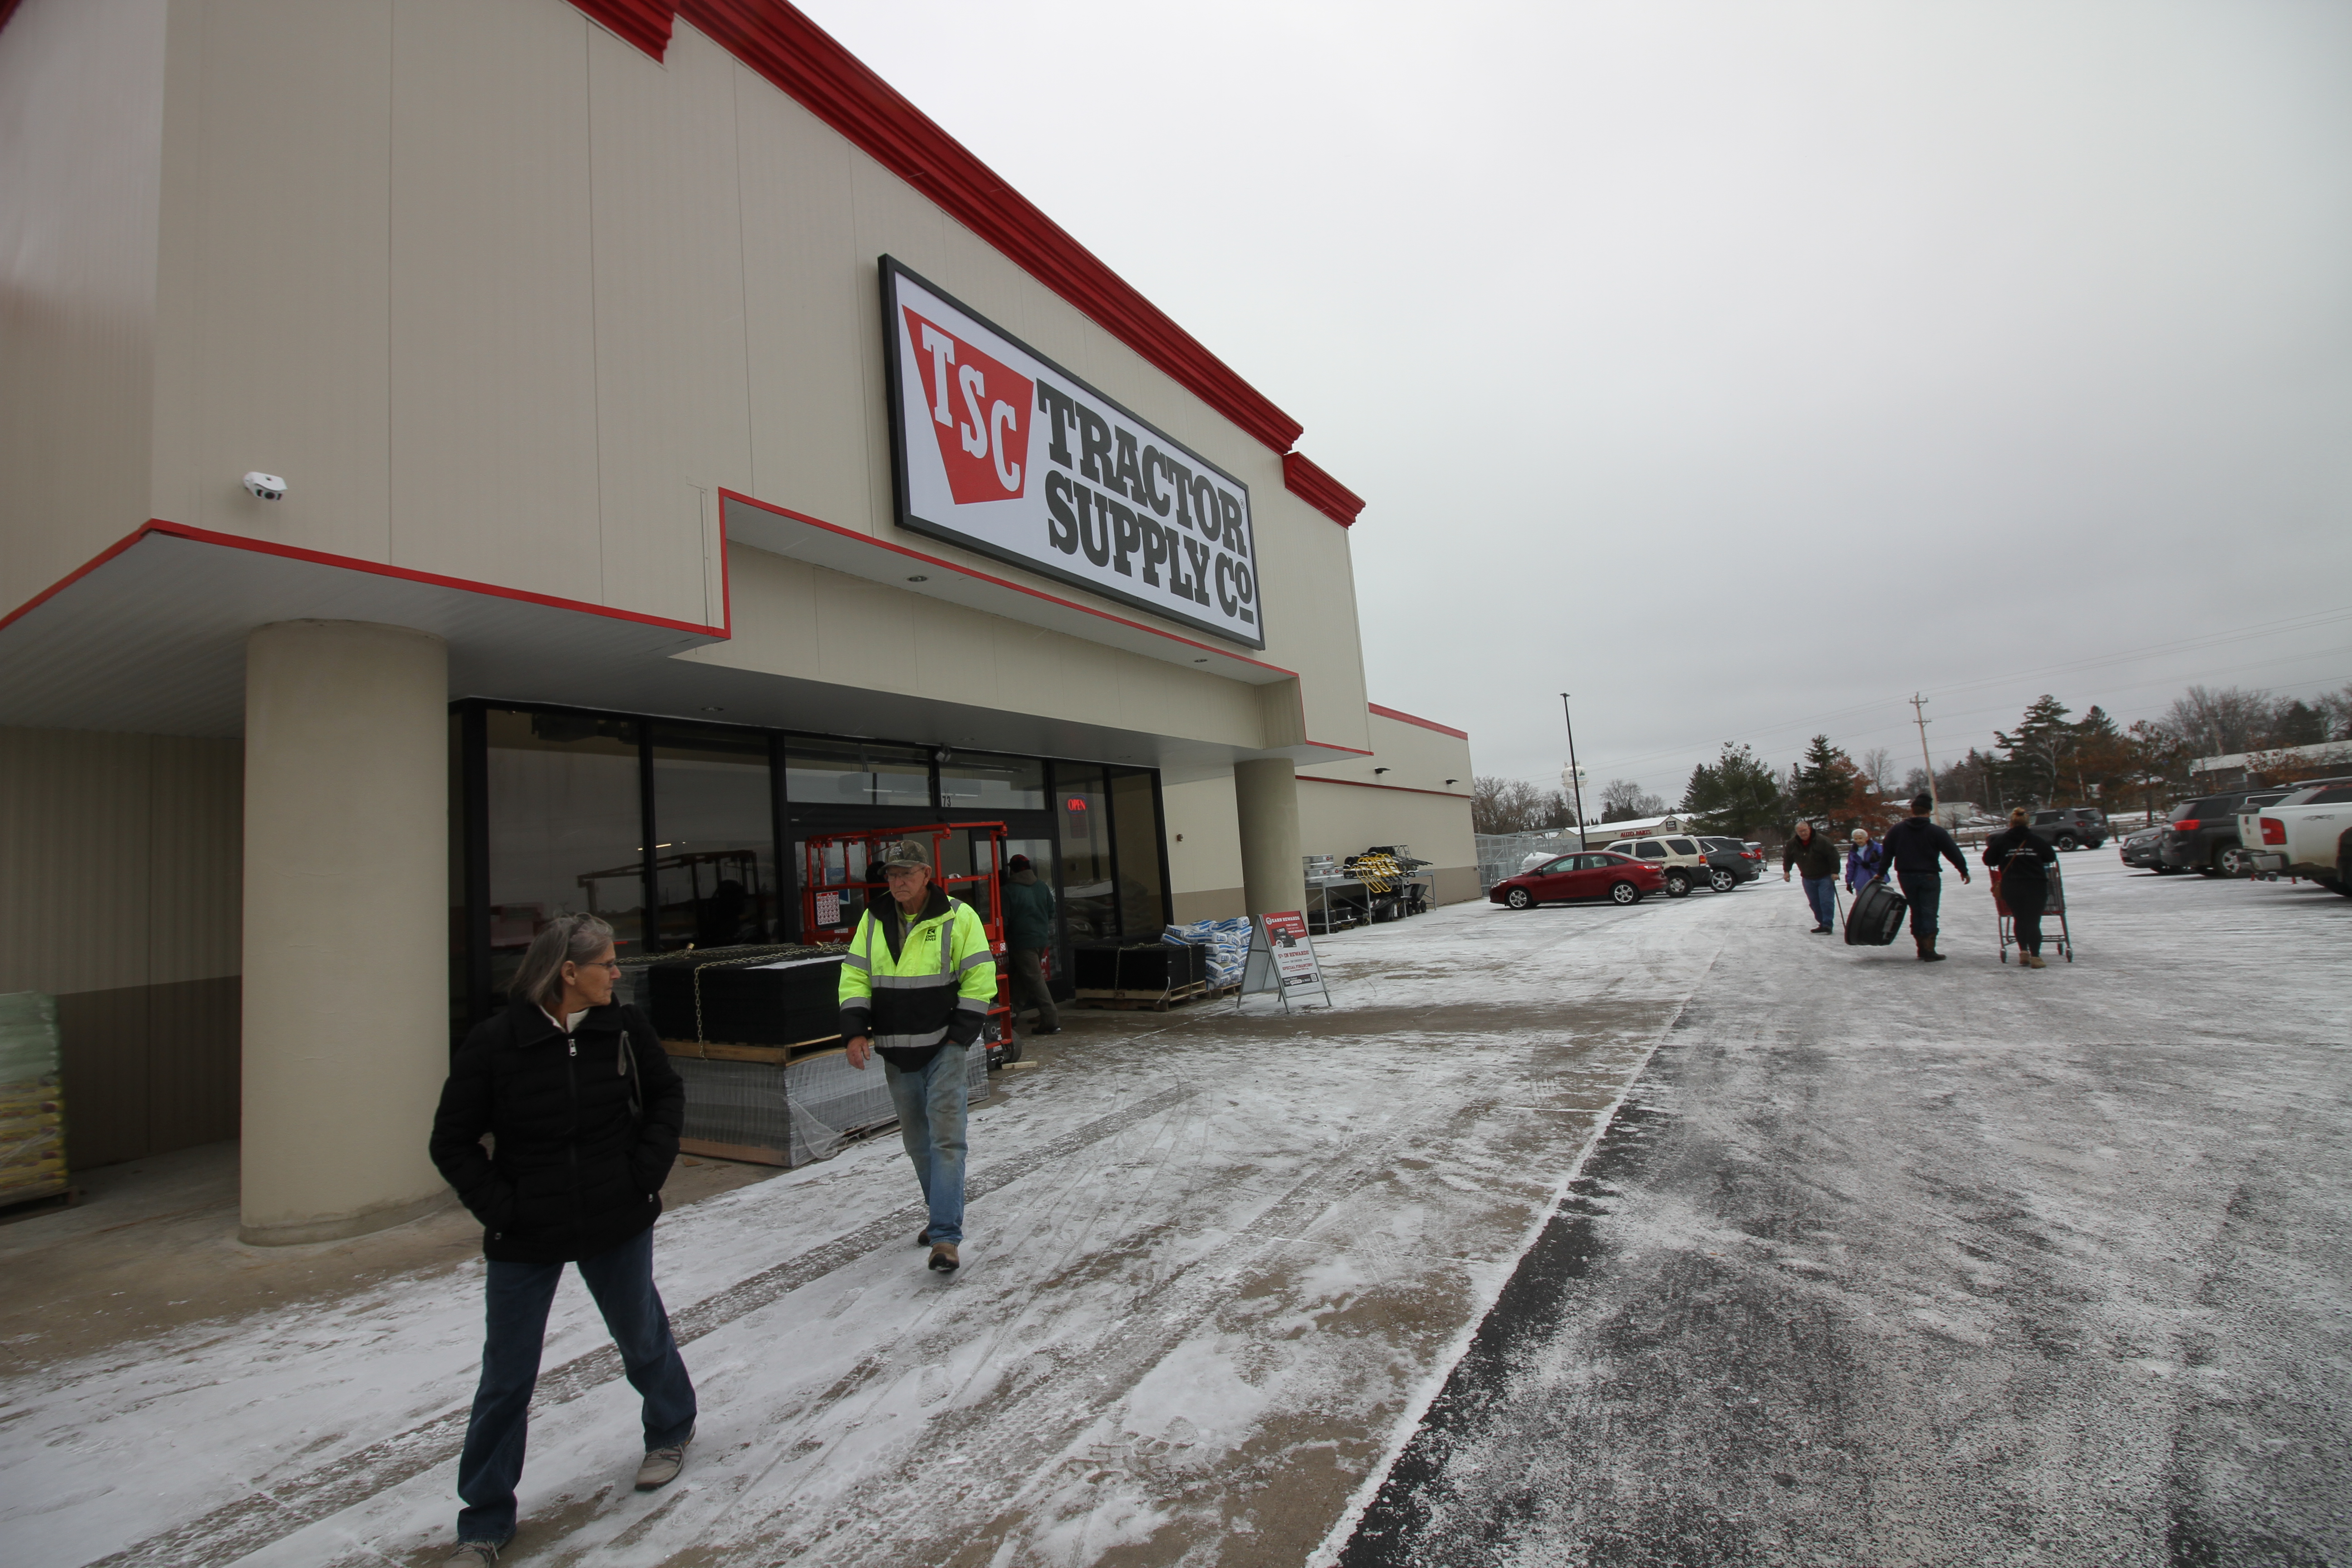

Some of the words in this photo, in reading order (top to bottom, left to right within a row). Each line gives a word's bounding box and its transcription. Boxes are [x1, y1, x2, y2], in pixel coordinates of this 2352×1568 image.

[921, 323, 1020, 492] TSC
[1036, 378, 1247, 559] TRACTOR
[1045, 470, 1210, 607] SUPPLY
[942, 796, 951, 807] 73
[1068, 799, 1087, 811] OPEN
